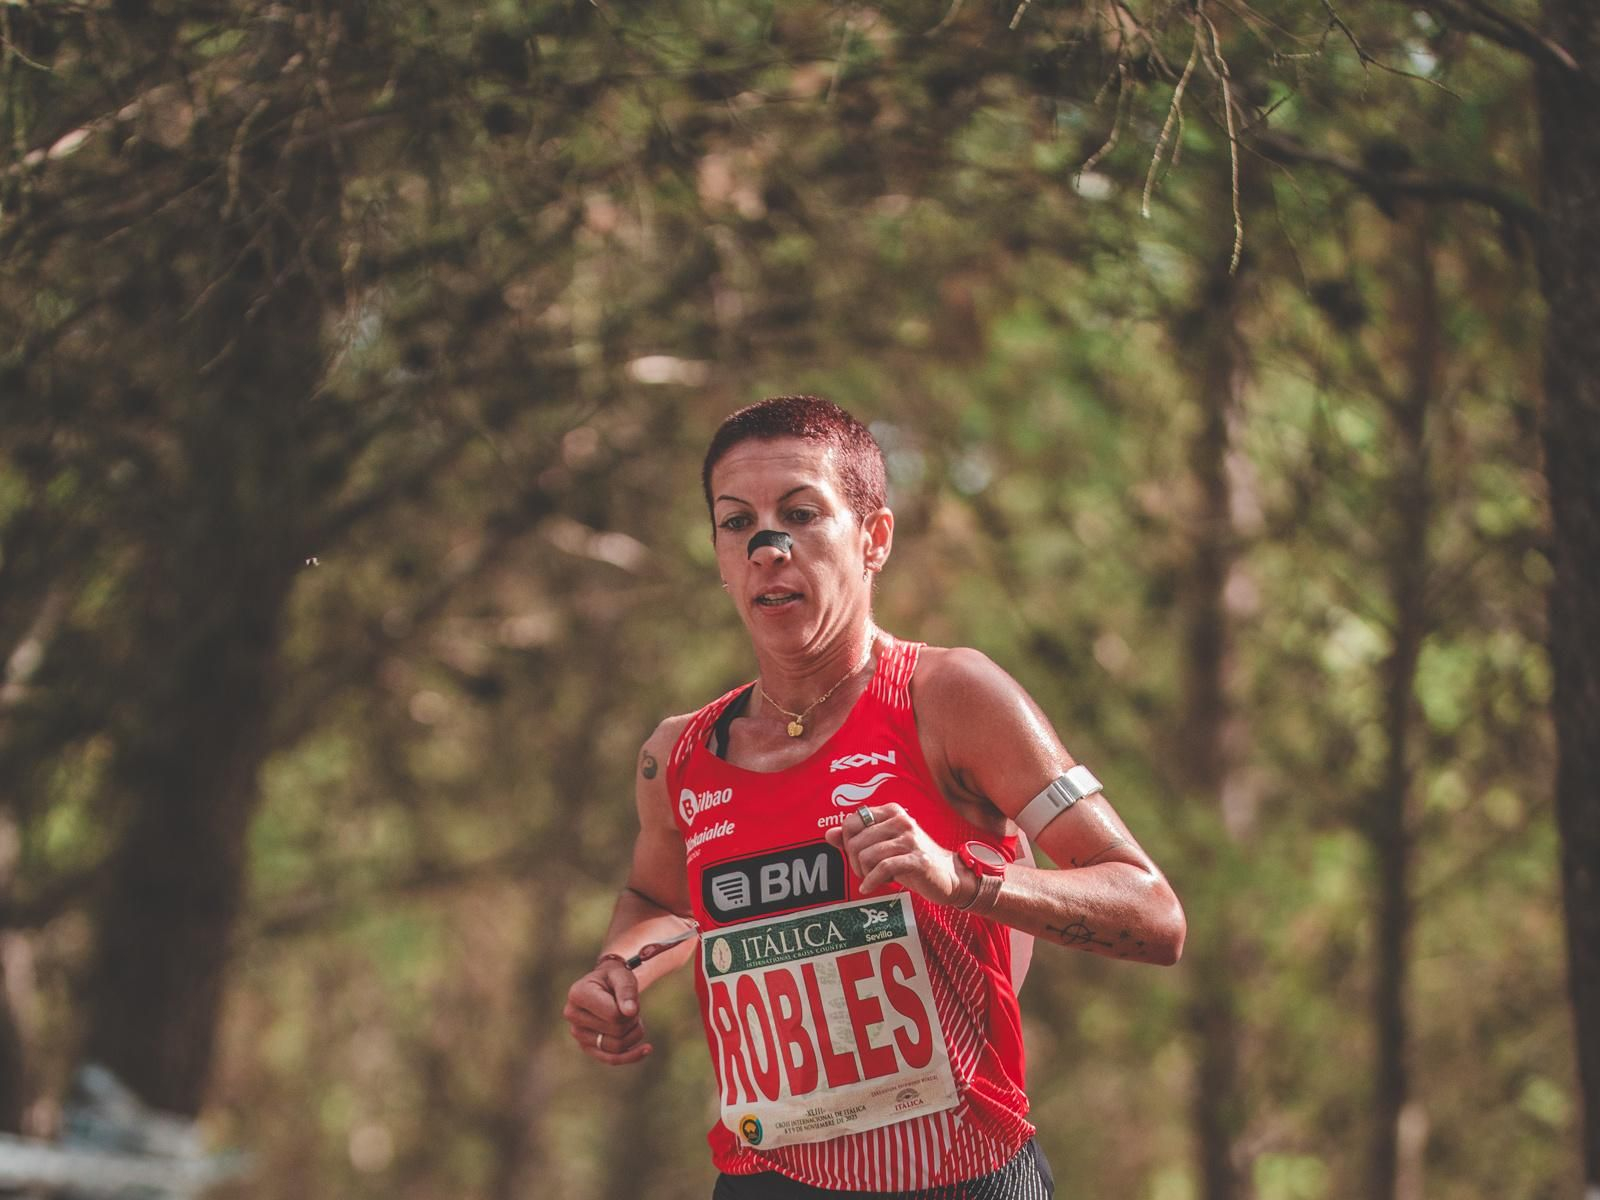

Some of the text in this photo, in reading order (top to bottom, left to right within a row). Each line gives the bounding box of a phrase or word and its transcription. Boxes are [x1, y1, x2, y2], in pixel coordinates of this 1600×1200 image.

[679, 788, 733, 827] Bilbao
[760, 853, 829, 904] BM
[740, 920, 847, 961] ITÁLICA
[865, 930, 893, 942] Sevilla
[746, 943, 848, 968] INTERNATIONAL CROSS COUNTRY
[710, 942, 934, 1106] ROBLES
[791, 1113, 834, 1127] INTERNACIONAL
[834, 1110, 842, 1118] DE
[803, 1119, 836, 1131] NOVIEMBRE
